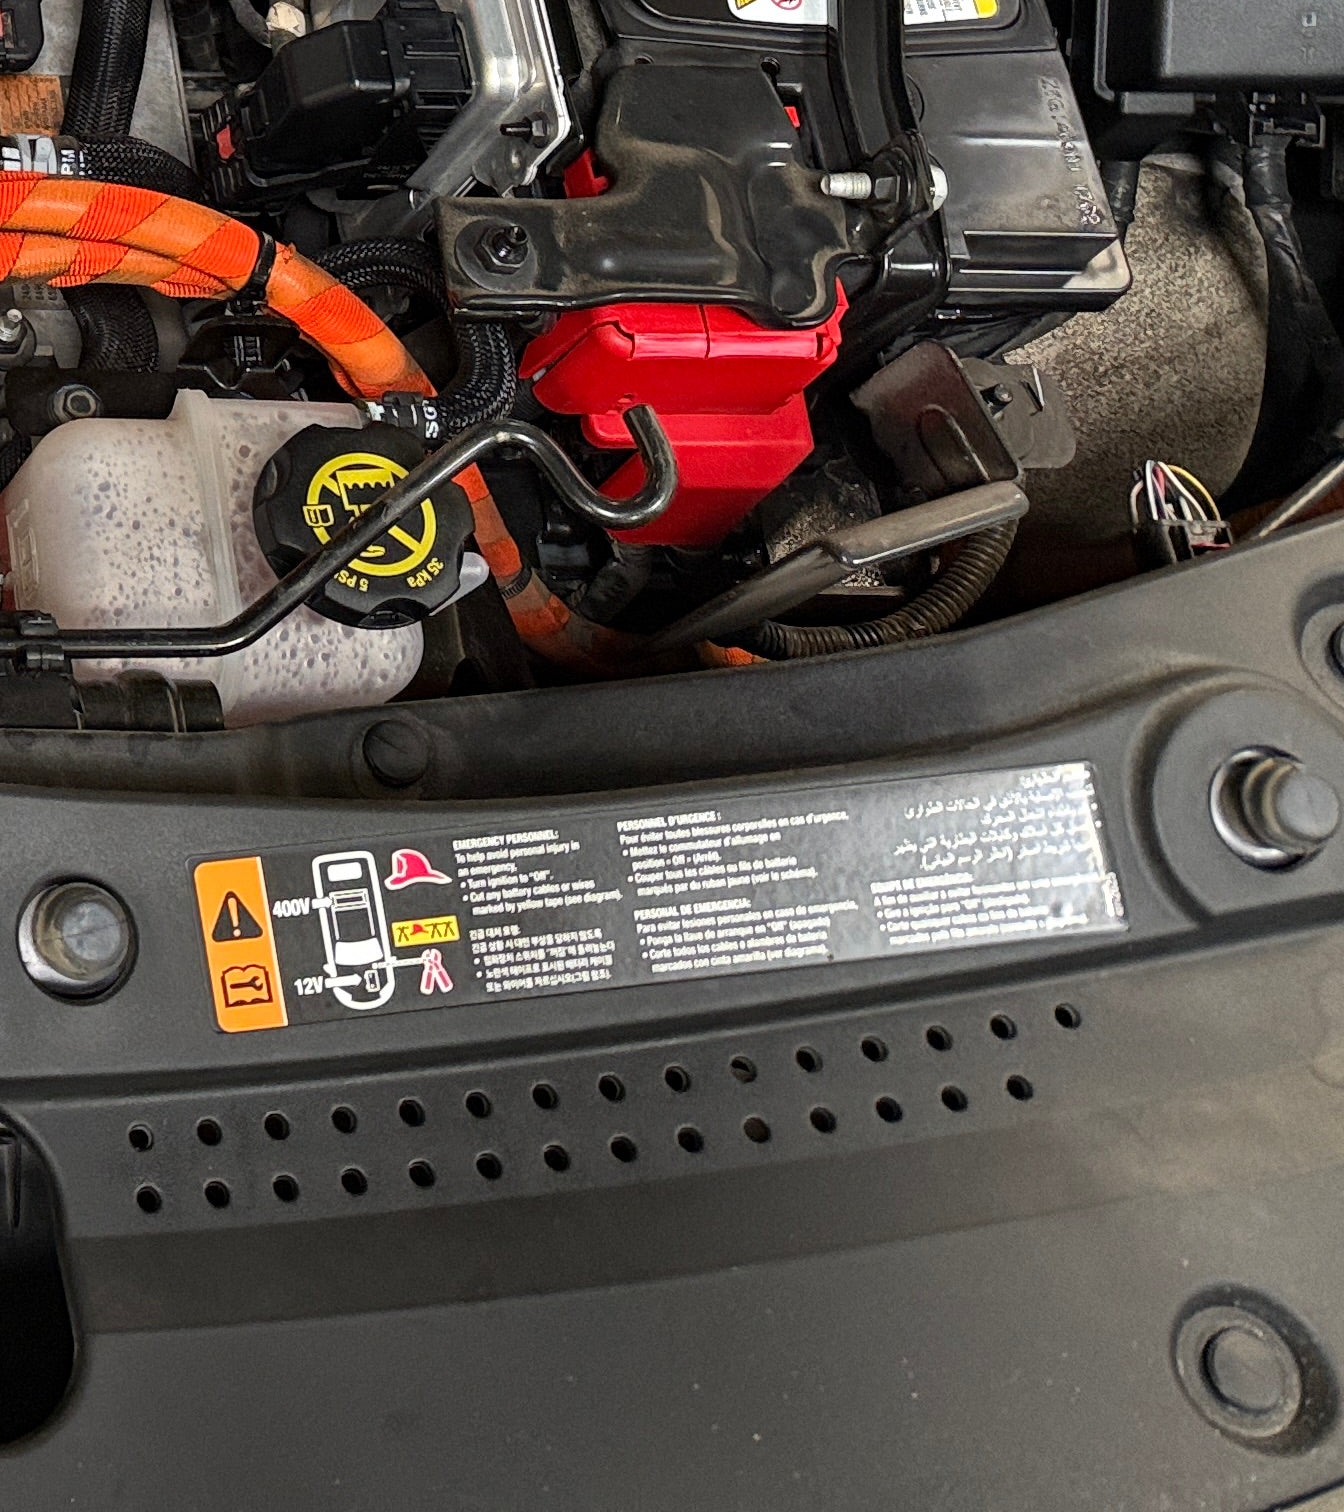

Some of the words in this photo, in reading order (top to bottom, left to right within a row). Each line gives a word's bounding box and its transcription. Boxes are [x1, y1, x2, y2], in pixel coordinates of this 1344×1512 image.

[426, 557, 444, 576] 35
[359, 578, 369, 593] 5
[406, 569, 433, 588] kPa
[616, 816, 668, 833] PERSONNEL
[452, 834, 505, 851] EMERGENCY
[619, 834, 640, 846] Pour
[455, 853, 466, 865] To
[466, 851, 486, 863] help
[486, 848, 509, 861] avoid
[509, 843, 546, 860] personal
[545, 842, 570, 856] injury
[570, 839, 581, 851] in
[467, 877, 487, 890] Turn
[487, 873, 519, 888] ignition
[519, 873, 529, 884] to
[469, 891, 485, 903] Cut
[485, 890, 502, 901] any
[502, 886, 532, 900] battery
[532, 883, 560, 896] cables
[560, 881, 571, 892] or
[272, 896, 310, 917] 400V
[471, 902, 505, 916] marked
[505, 901, 516, 913] by
[516, 898, 544, 913] yellow
[544, 895, 564, 909] tape
[633, 905, 680, 921] PERSONAL
[679, 903, 693, 916] DE
[293, 974, 324, 995] 12V
